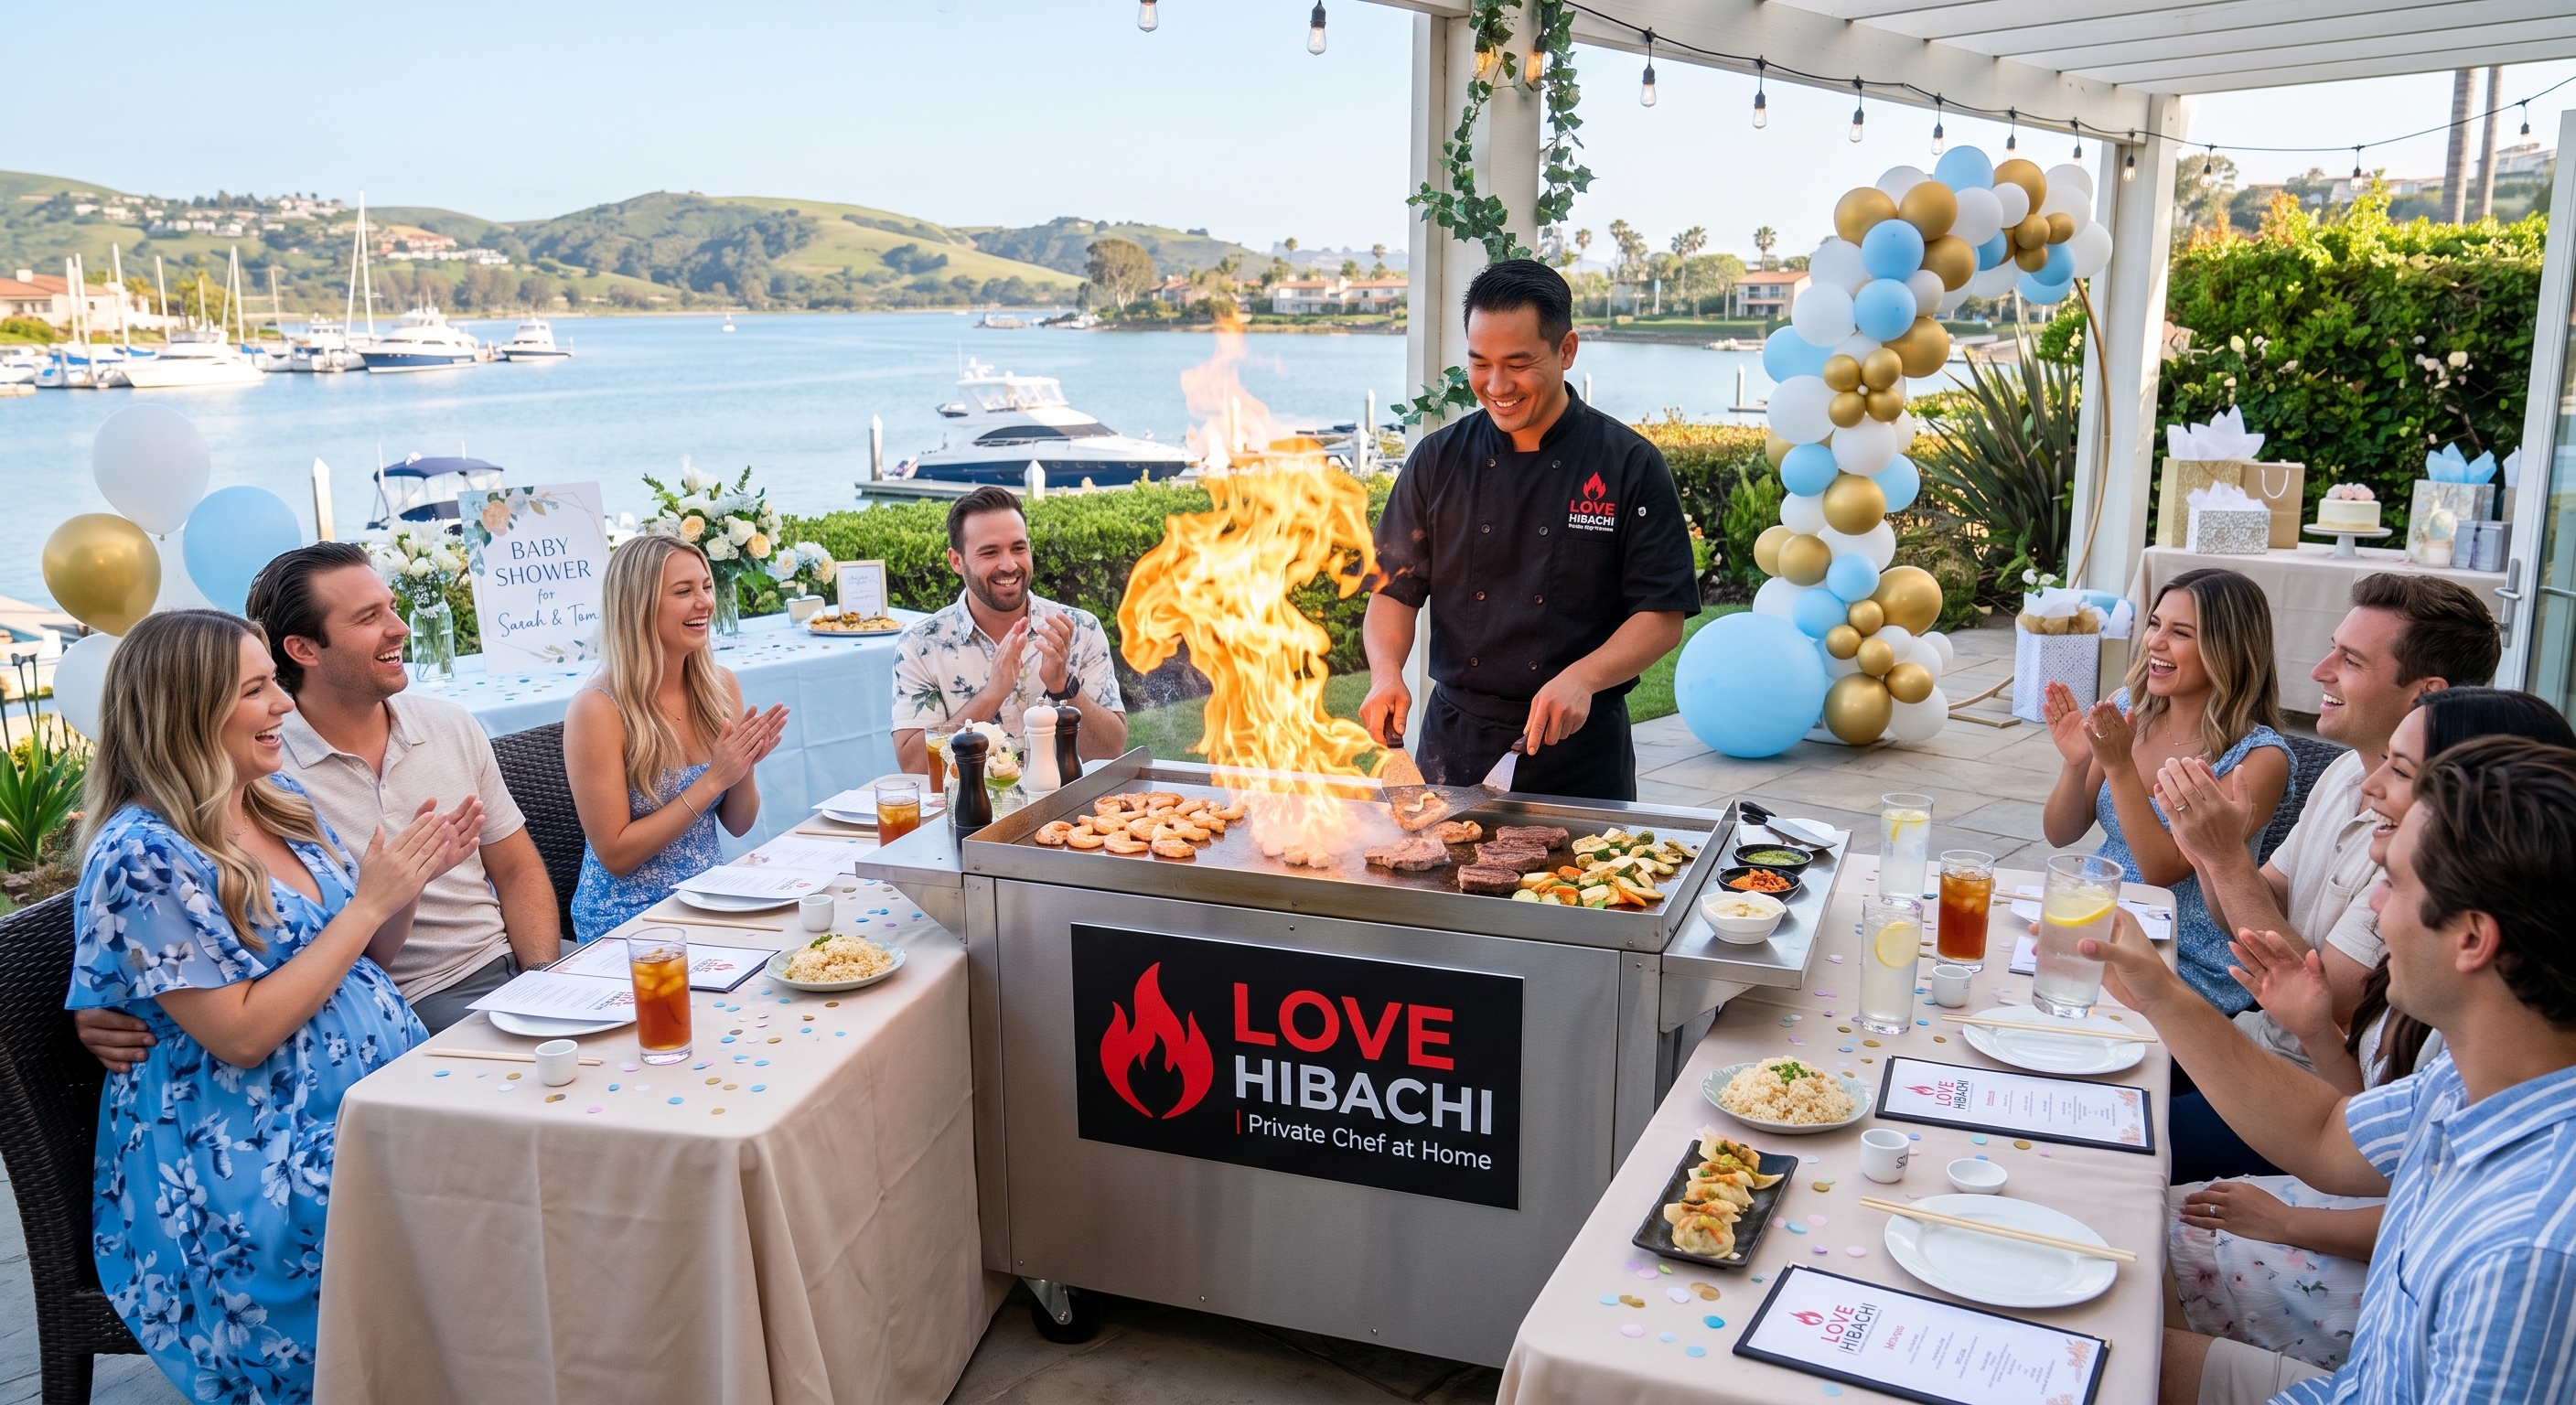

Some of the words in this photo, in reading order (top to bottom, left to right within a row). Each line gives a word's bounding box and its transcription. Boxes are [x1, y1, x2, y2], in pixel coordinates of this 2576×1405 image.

[1569, 513, 1615, 526] HIBACHI
[1570, 499, 1615, 516] LOVE
[510, 537, 568, 560] BABY
[495, 559, 592, 587] SHOWER
[538, 588, 556, 605] for
[498, 609, 547, 638] Sarah
[552, 608, 563, 626] &
[567, 603, 600, 627] Tom
[1233, 981, 1454, 1071] LOVE
[1235, 1054, 1493, 1135] HIBACHI
[1935, 1080, 1955, 1107] LOVE
[1248, 1113, 1326, 1144] Private
[1332, 1127, 1387, 1154] Chef
[1391, 1141, 1415, 1159] at
[1422, 1142, 1492, 1171] Home
[1819, 1304, 1855, 1343] LOVE
[1839, 1303, 1878, 1352] HIBACHI
